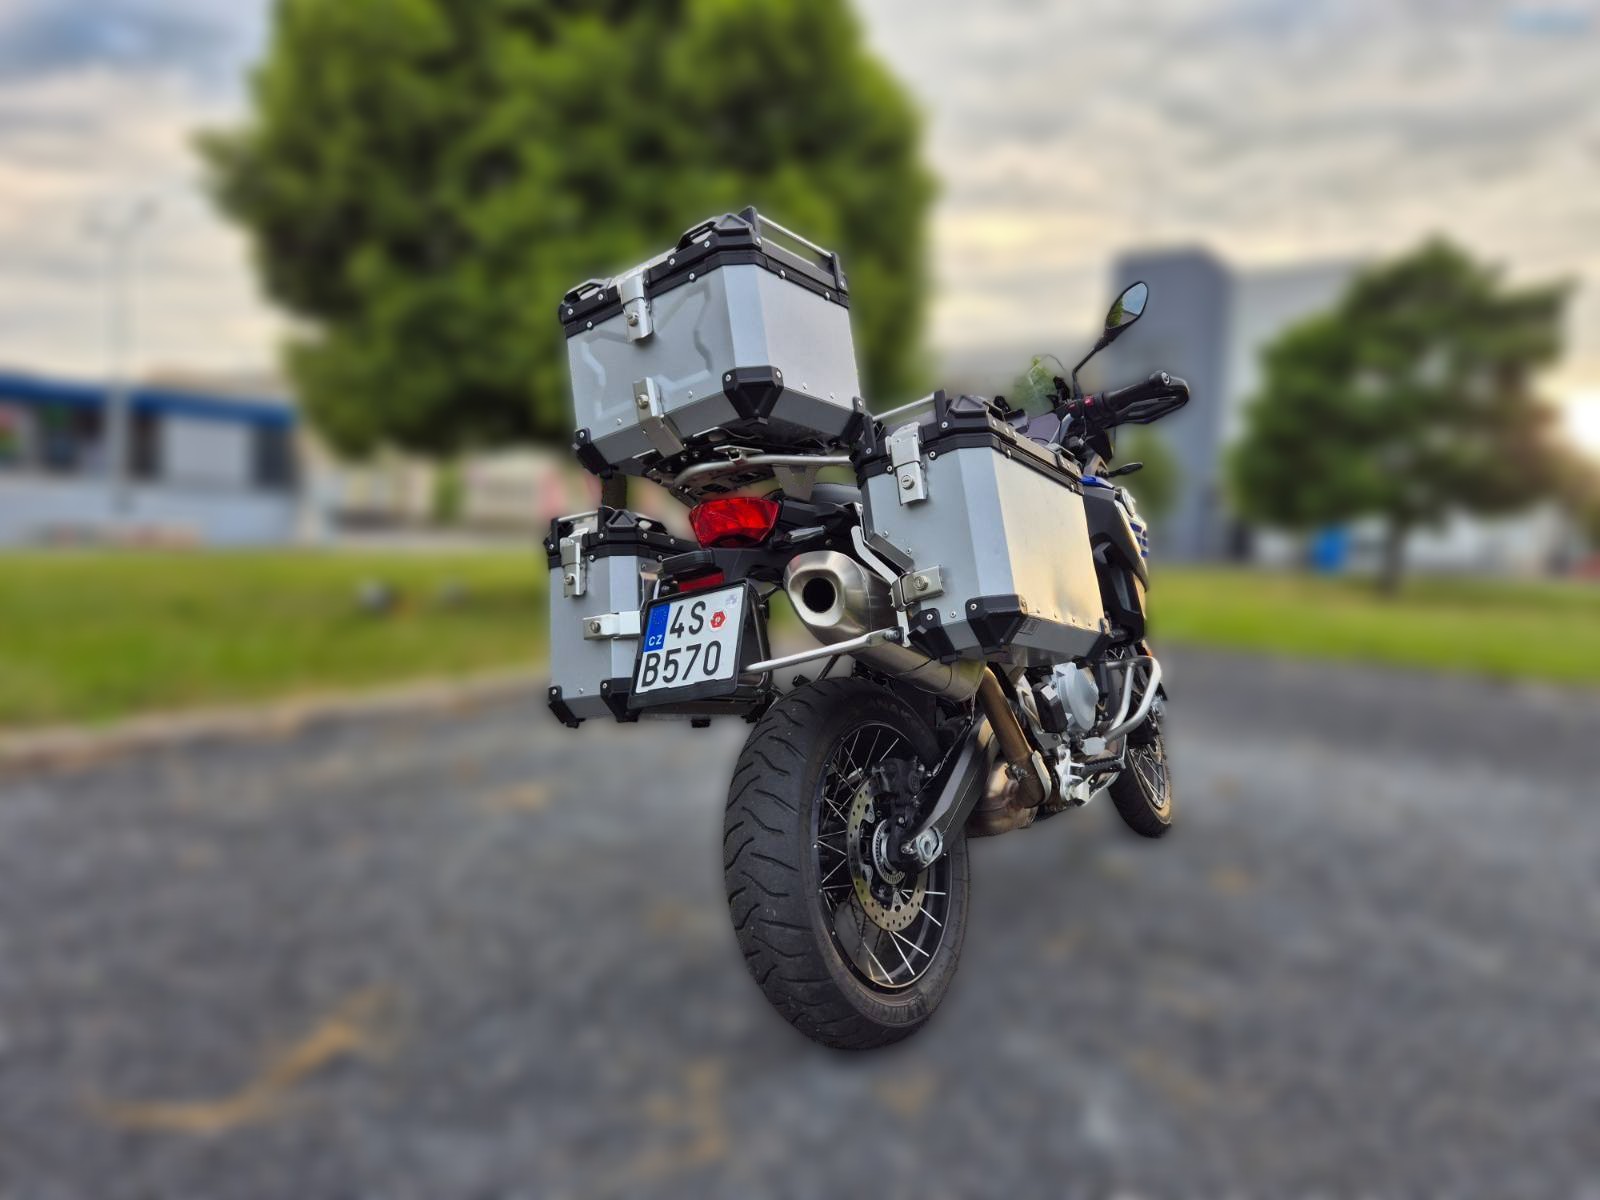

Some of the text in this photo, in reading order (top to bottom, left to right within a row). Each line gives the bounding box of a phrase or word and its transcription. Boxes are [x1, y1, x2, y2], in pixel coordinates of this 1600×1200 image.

[669, 601, 706, 639] 4S
[648, 634, 662, 646] CZ
[641, 640, 721, 687] B570
